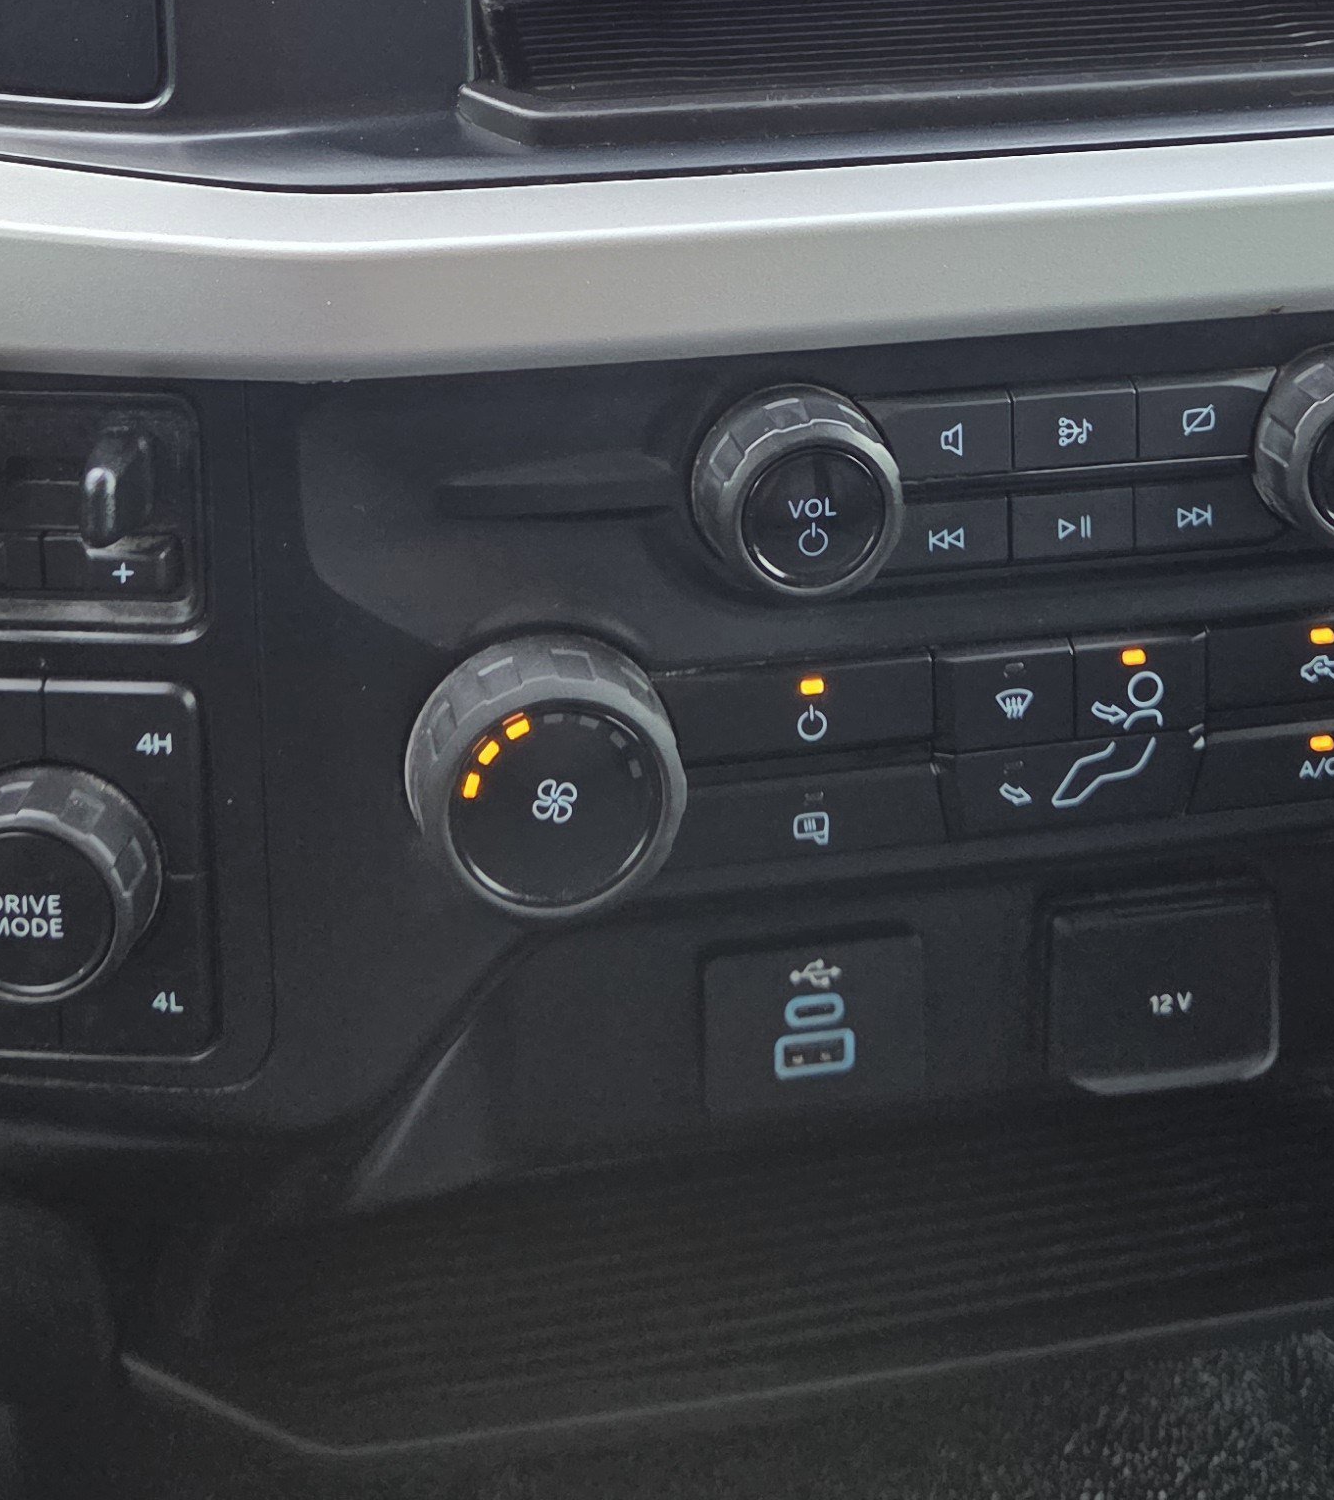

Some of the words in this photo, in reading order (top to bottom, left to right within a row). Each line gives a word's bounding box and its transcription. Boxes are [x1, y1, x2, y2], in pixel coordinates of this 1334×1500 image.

[788, 498, 838, 518] VOL
[136, 732, 172, 755] 4H
[152, 991, 184, 1014] 4L
